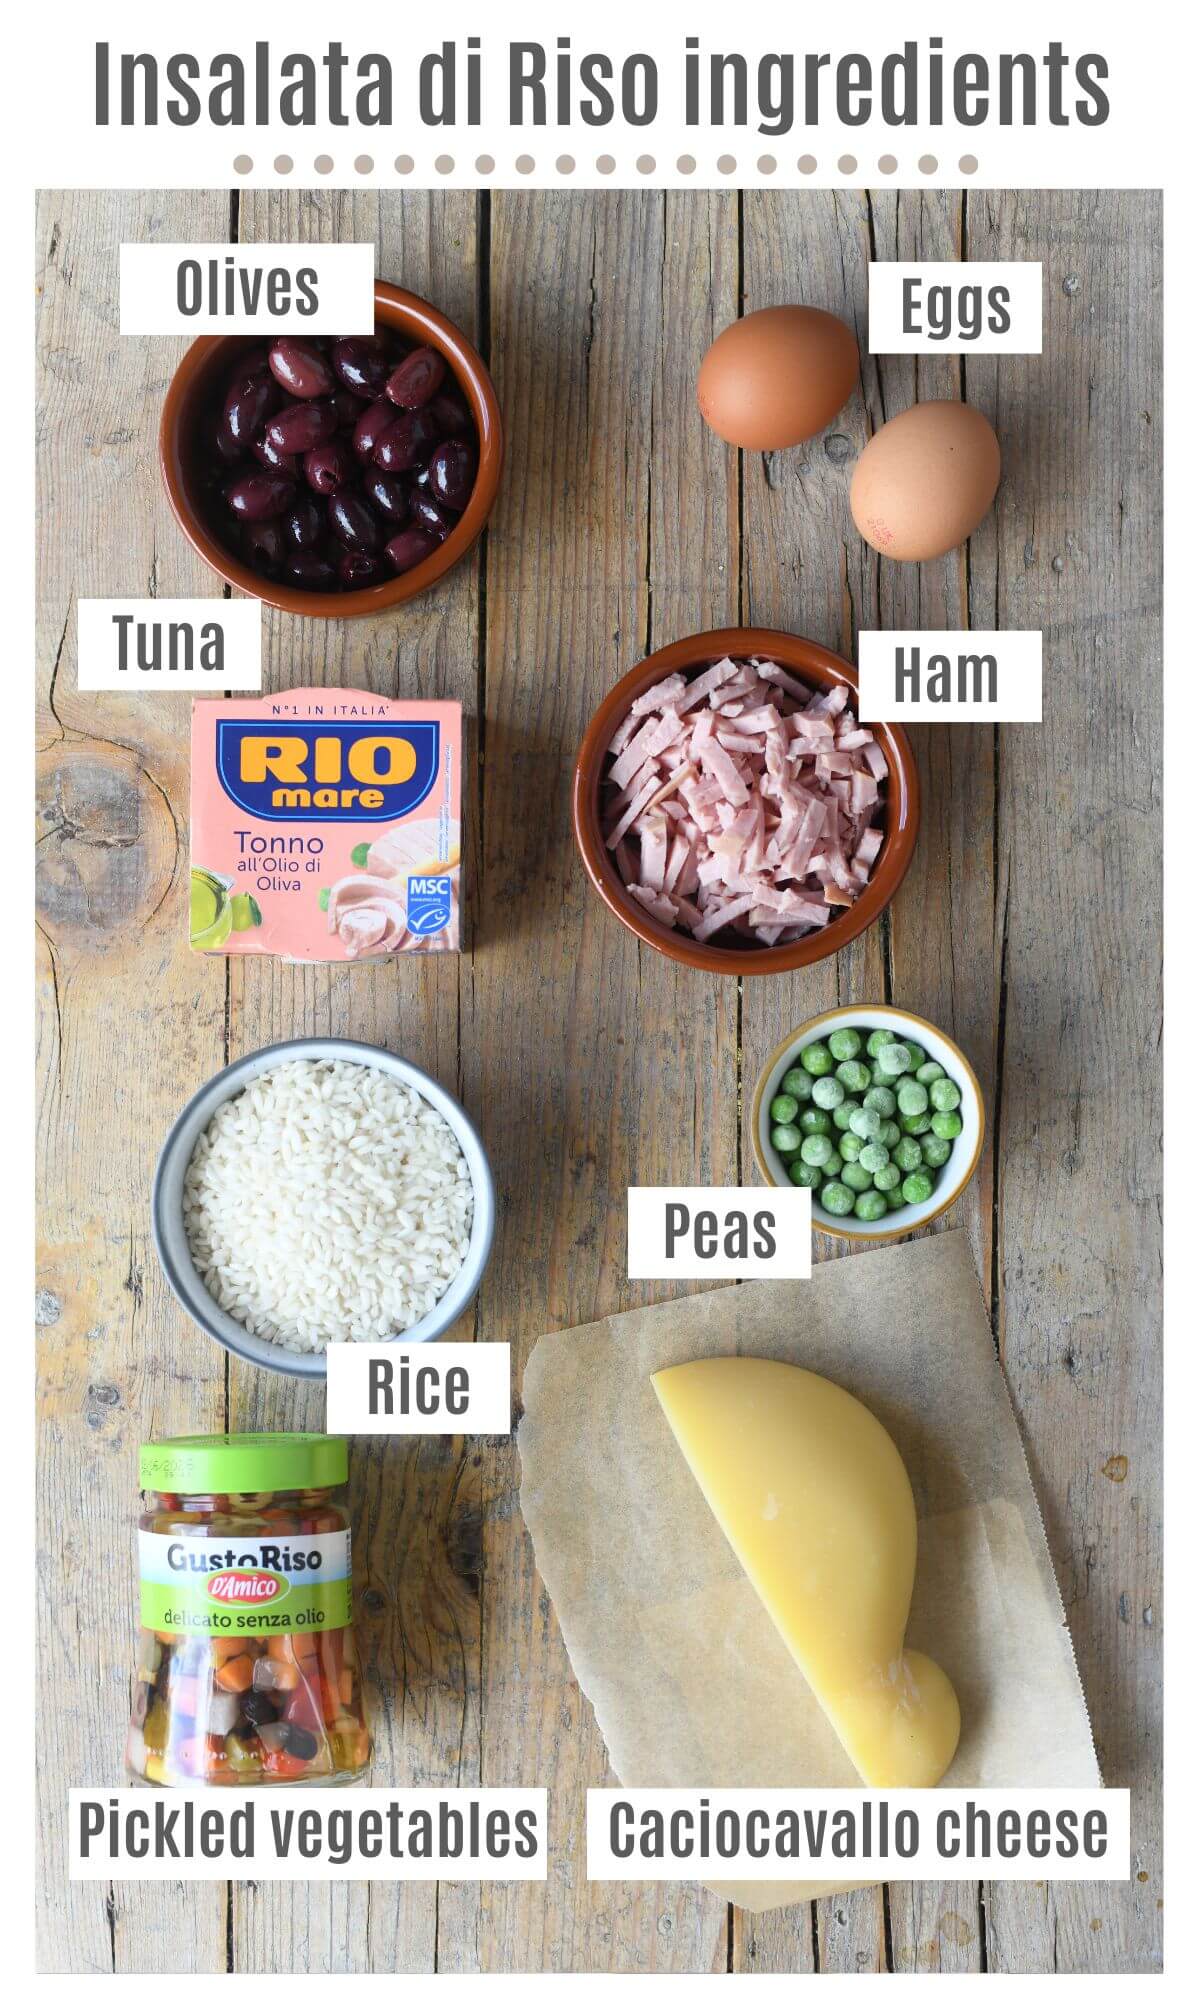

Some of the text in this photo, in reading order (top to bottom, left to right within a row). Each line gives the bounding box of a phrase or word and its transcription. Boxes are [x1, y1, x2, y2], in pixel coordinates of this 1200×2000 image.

[308, 705, 324, 715] IN
[240, 736, 417, 785] RIO
[272, 788, 385, 809] mare
[233, 831, 324, 854] Tonno
[305, 857, 321, 873] di
[256, 876, 301, 891] Oliva
[410, 879, 449, 895] MSC
[211, 1573, 277, 1599] D'Amico
[164, 1607, 325, 1629] delicato senza olio
